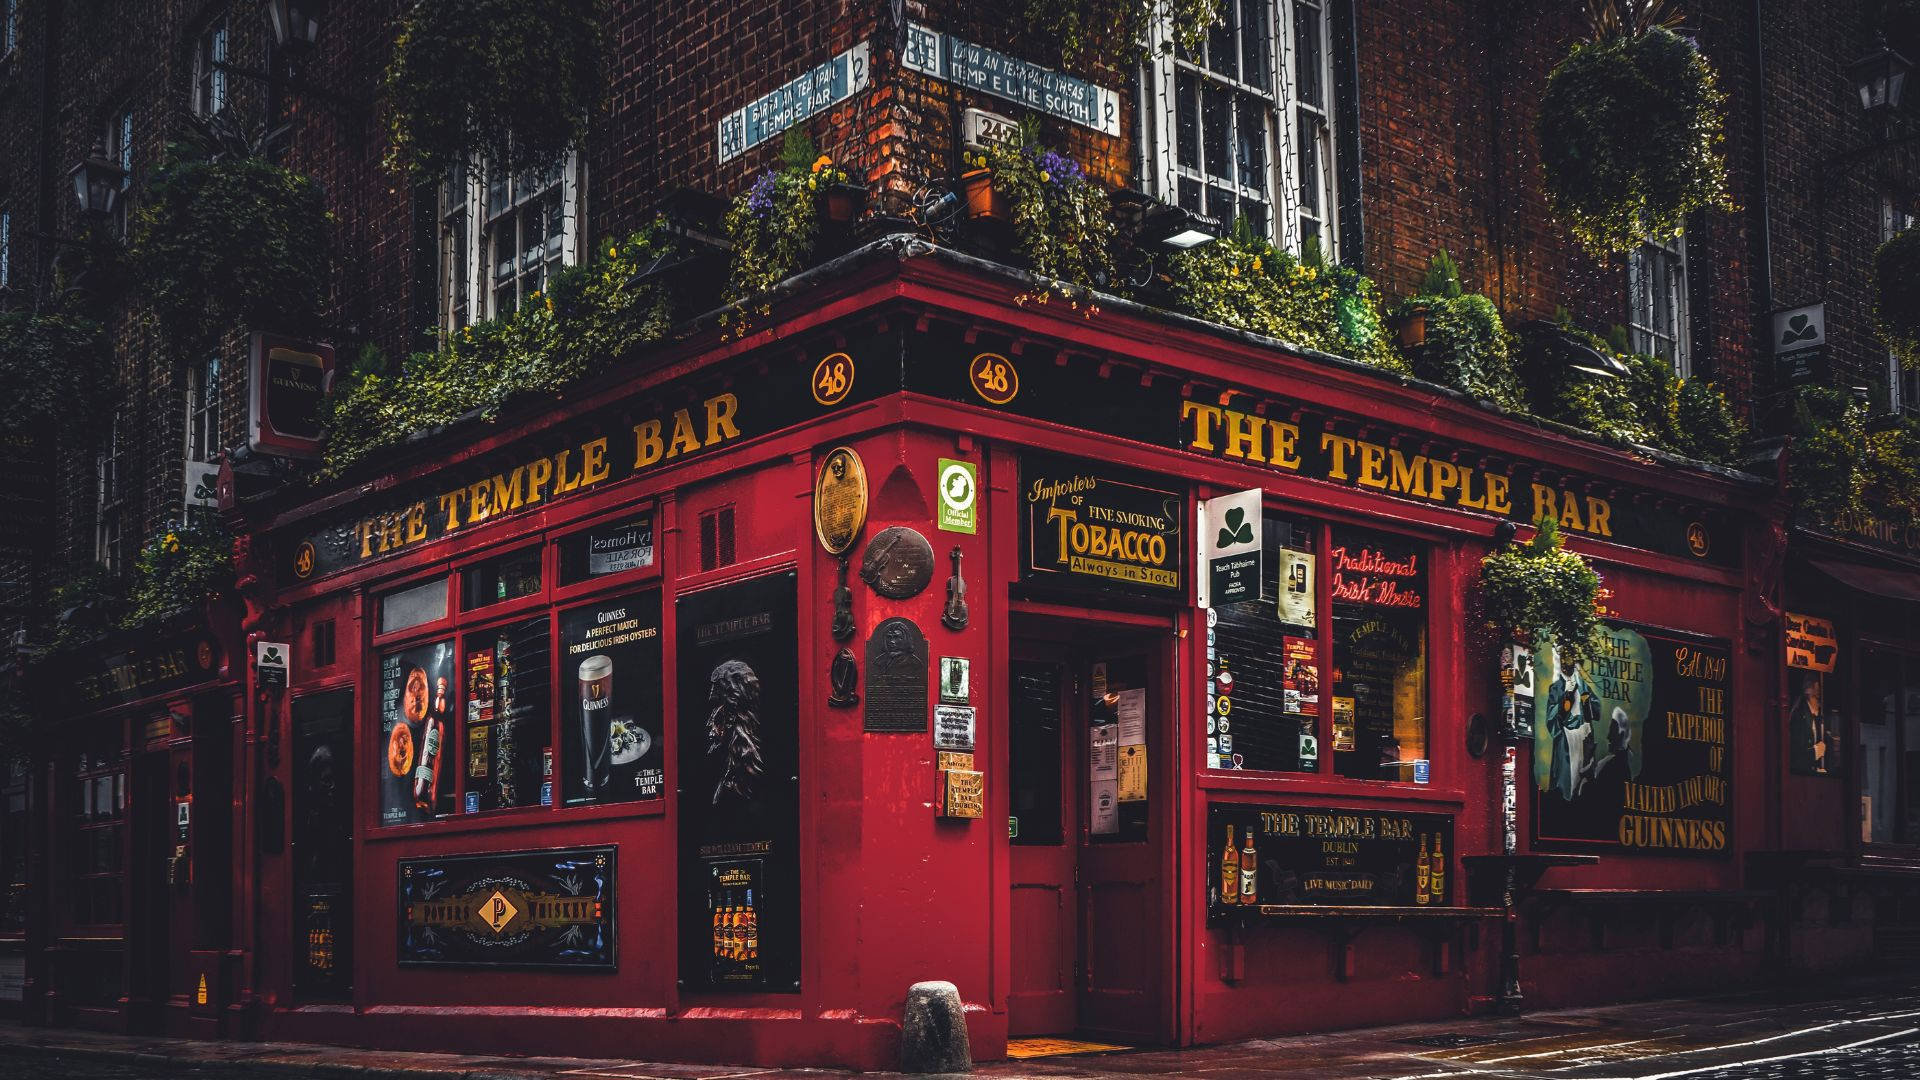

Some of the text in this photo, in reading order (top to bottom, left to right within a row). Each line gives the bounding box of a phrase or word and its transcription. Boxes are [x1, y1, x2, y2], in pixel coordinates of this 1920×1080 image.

[854, 57, 864, 81] 2
[983, 54, 999, 71] AN
[952, 62, 1001, 91] TEMPE
[1045, 94, 1088, 121] SOUTH
[1104, 103, 1114, 124] 2
[272, 375, 319, 392] GUINNESS
[818, 362, 856, 397] 48
[987, 359, 1019, 393] 48
[355, 392, 742, 559] THE TEMPLE BAR
[1182, 399, 1613, 538] THE TEMPLE BAR
[1028, 474, 1097, 508] Importers
[1070, 495, 1084, 506] OF
[944, 516, 972, 527] Member
[946, 508, 969, 519] Official
[1088, 505, 1165, 531] FINE SMOKING
[1046, 506, 1167, 566] TOBACCO
[297, 549, 311, 573] 48
[1072, 556, 1176, 586] Always in Stock
[1332, 546, 1417, 576] Traditional
[1230, 570, 1240, 578] Pub
[1332, 573, 1376, 601] Irish
[1376, 581, 1421, 608] Music
[598, 608, 626, 623] GUINNESS
[585, 619, 638, 638] A PERFECT MATCH
[569, 627, 657, 655] FOR DELICIOUS IRISH OYSTERS
[1588, 656, 1644, 683] TEMPLE
[1792, 651, 1809, 666] Area
[1602, 678, 1631, 703] BAR
[1698, 686, 1724, 715] THE
[583, 697, 609, 710] GUINNESS
[1666, 711, 1726, 745] EMPEROR
[1709, 746, 1726, 773] OF
[634, 774, 663, 787] TEMPLE
[642, 768, 655, 777] THE
[641, 785, 656, 794] BAR
[1623, 774, 1728, 812] MALTED LIQUORS
[1260, 811, 1413, 838] THE TEMPLE BAR
[1618, 814, 1727, 850] GUINNESS
[1322, 841, 1359, 853] DUBLIN
[719, 873, 740, 882] TEMPLE
[1304, 878, 1376, 891] LIVE MUSIC DAILY
[424, 904, 470, 922] POWERS
[492, 896, 507, 926] P
[528, 901, 589, 921] WHISKEY
